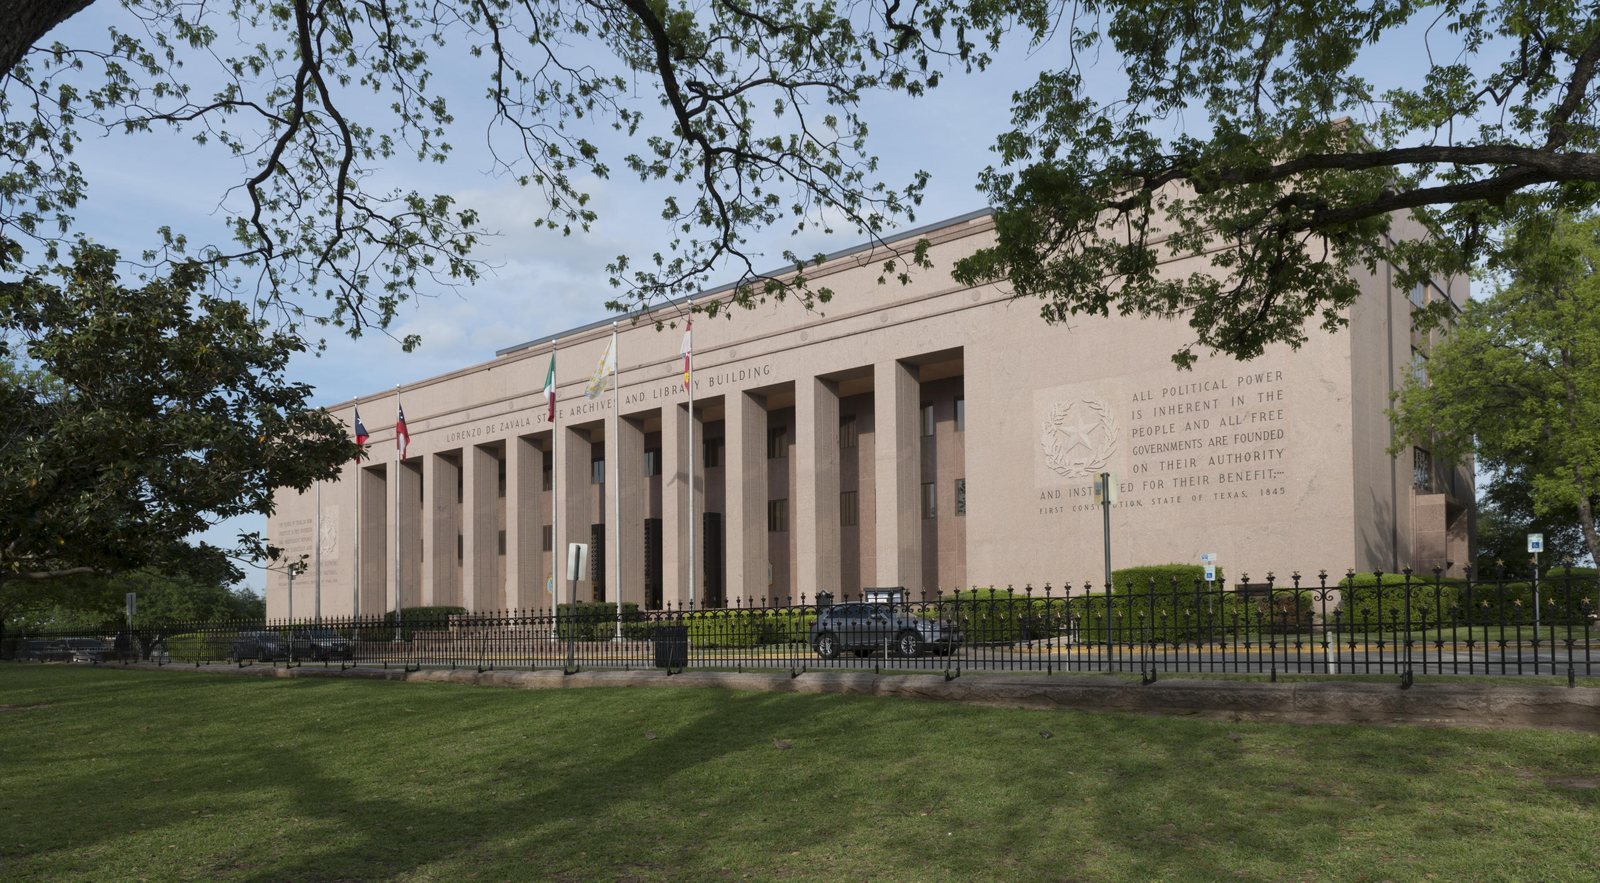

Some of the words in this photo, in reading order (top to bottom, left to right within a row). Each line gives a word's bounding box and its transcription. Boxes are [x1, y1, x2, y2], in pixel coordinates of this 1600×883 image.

[1132, 390, 1153, 403] ALL
[1162, 379, 1228, 398] POLITICAL
[1237, 370, 1283, 387] POWER
[446, 427, 482, 443] LORENZO
[486, 425, 496, 435] DE
[500, 417, 531, 432] ZAVALA
[537, 409, 564, 423] STE
[625, 391, 646, 405] AND
[653, 380, 700, 400] LIBRAY
[709, 364, 771, 388] BUILDING
[1131, 409, 1143, 420] IS
[1153, 399, 1219, 417] INHERENT
[1231, 395, 1245, 407] IN
[1258, 389, 1284, 403] THE
[1132, 423, 1175, 439] PEOPLE
[1184, 419, 1210, 432] AND
[1219, 414, 1242, 428] ALL
[1251, 409, 1284, 423] FREE
[1132, 438, 1203, 456] GOVERNMENTS
[1208, 435, 1229, 447] ARE
[1234, 429, 1284, 445] FOUNDED
[1132, 463, 1148, 474] ON
[1159, 457, 1197, 471] THEIR
[1208, 448, 1285, 466] AUTHORITY
[1039, 506, 1064, 515] FIRST
[1151, 495, 1182, 505] STATE
[1191, 494, 1203, 502] OF
[1260, 487, 1286, 497] 1845
[1040, 489, 1061, 500] AND
[1069, 482, 1134, 498] INSTED
[1142, 479, 1165, 491] FOR
[1173, 475, 1210, 488] THEIR
